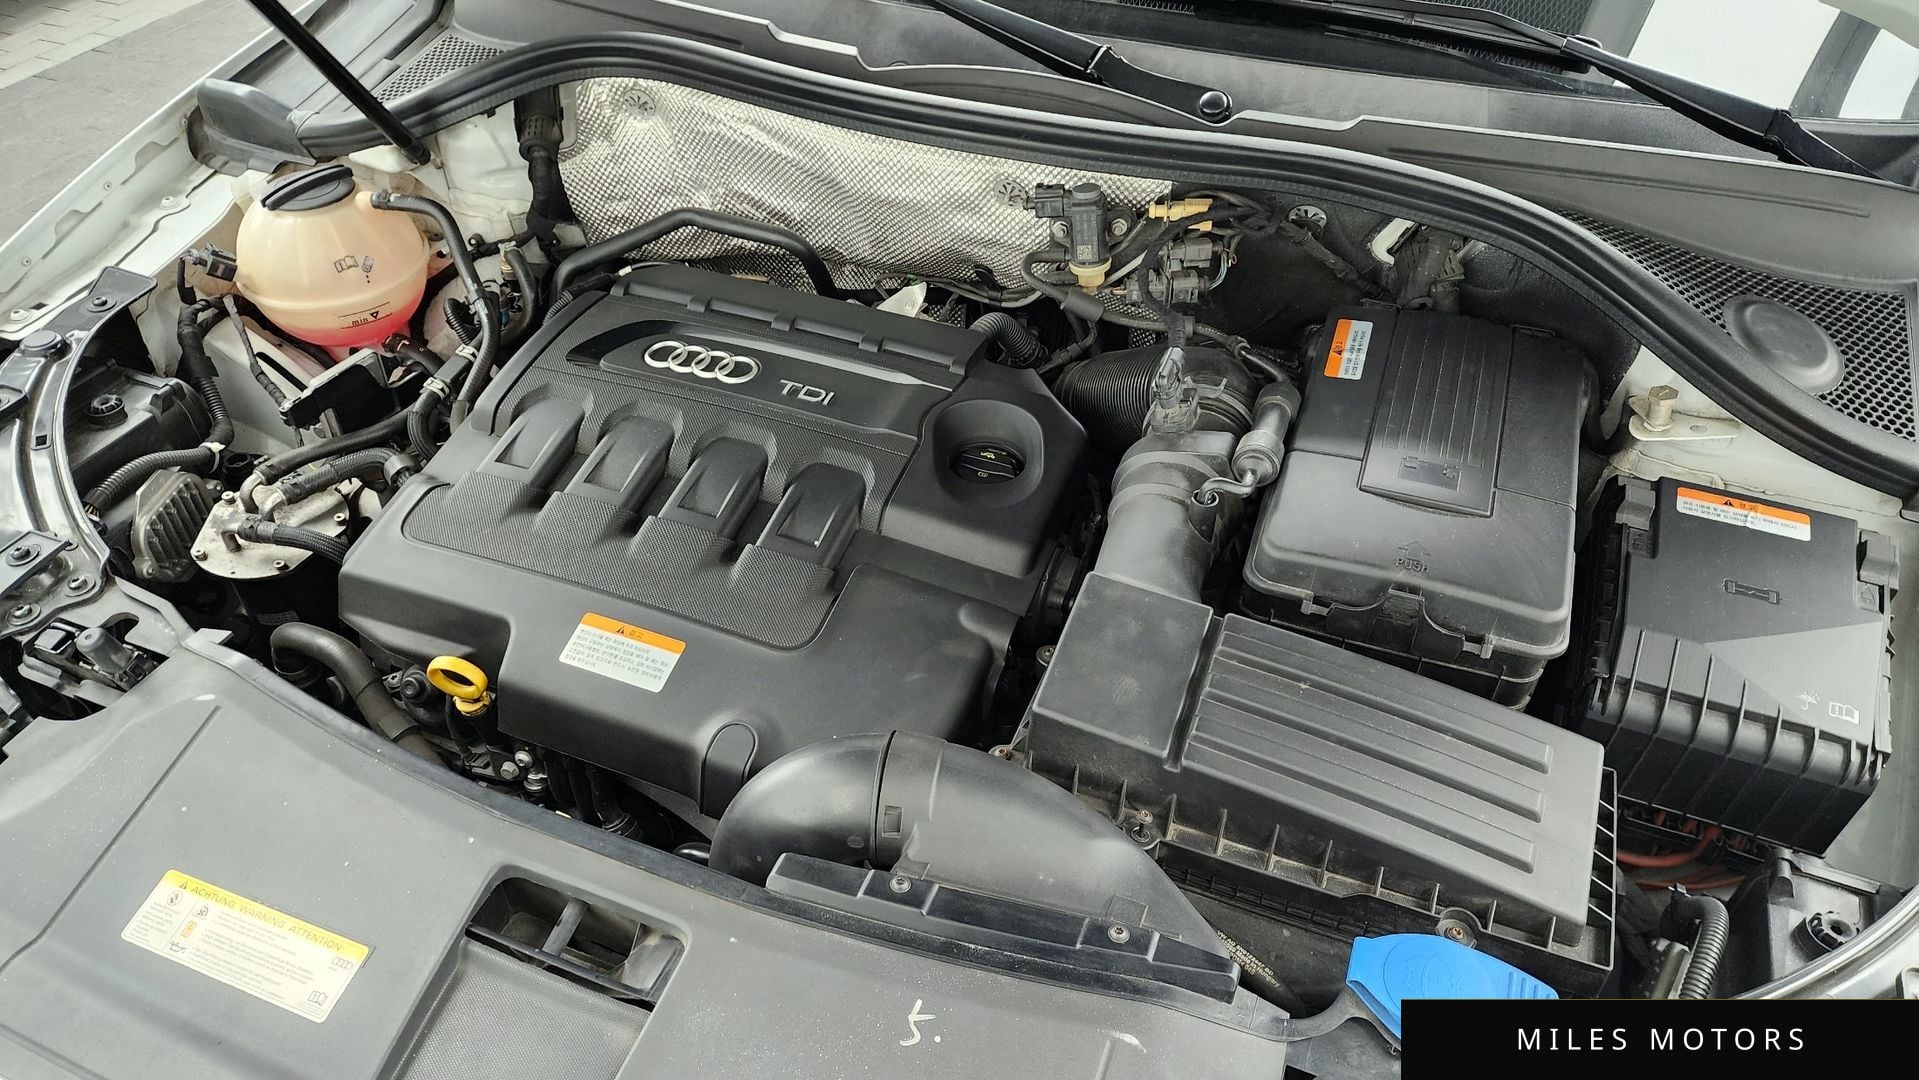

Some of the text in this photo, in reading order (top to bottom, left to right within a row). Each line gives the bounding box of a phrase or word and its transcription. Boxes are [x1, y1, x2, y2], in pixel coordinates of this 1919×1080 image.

[351, 317, 368, 326] min
[779, 379, 836, 406] TDI
[1395, 557, 1430, 574] PUSH
[191, 886, 344, 952] ACHTUNG WARNING ATTENTION
[1256, 965, 1281, 988] Hungary
